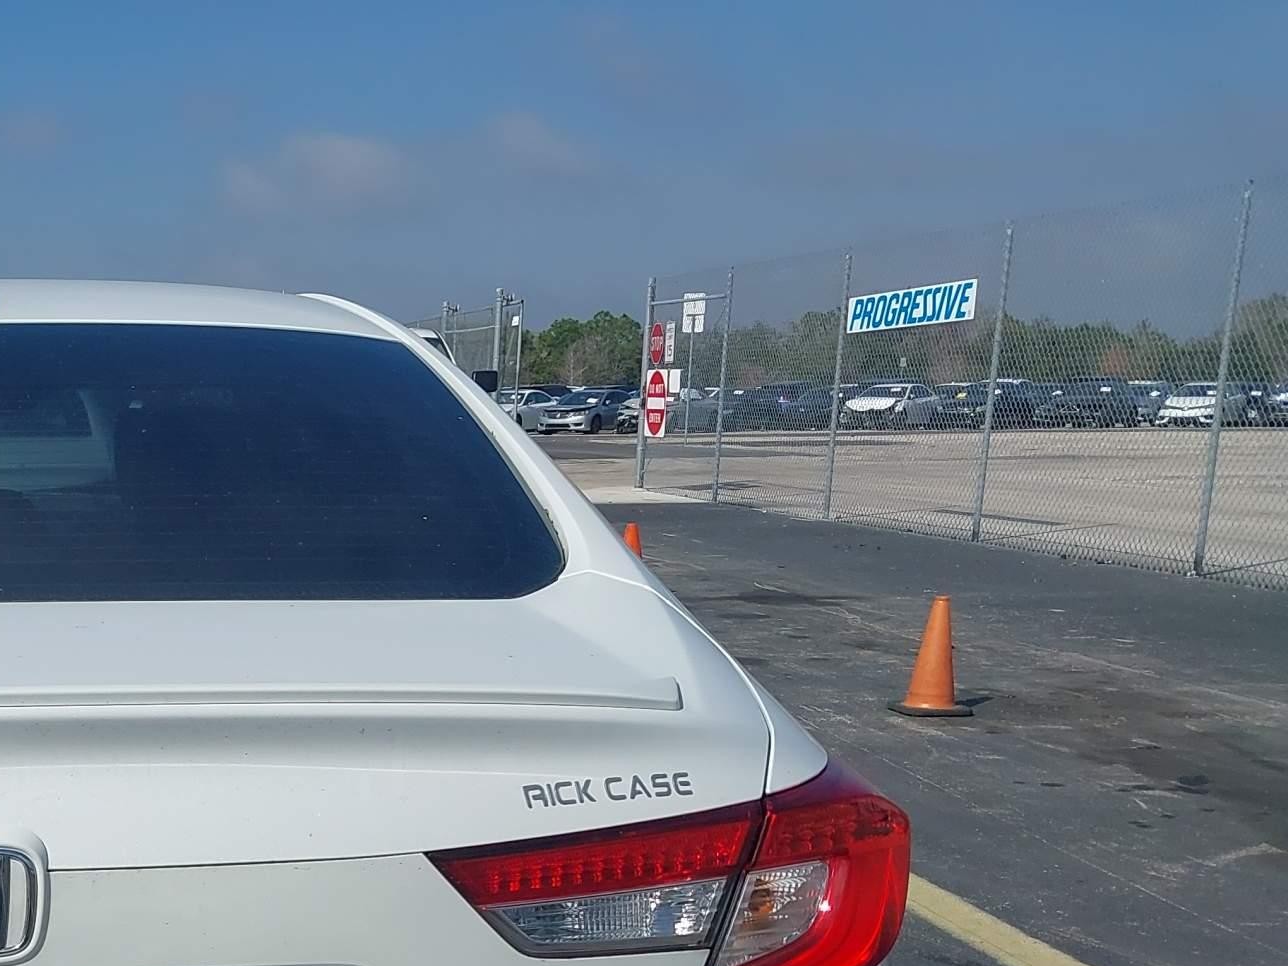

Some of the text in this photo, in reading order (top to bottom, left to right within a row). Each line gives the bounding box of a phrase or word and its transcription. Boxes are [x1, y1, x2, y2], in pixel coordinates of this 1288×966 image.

[850, 282, 973, 331] PROGRESSIVE
[650, 336, 663, 352] STOP
[656, 383, 664, 394] NOT
[649, 412, 661, 423] ENTER
[523, 772, 694, 809] RICK CASE
